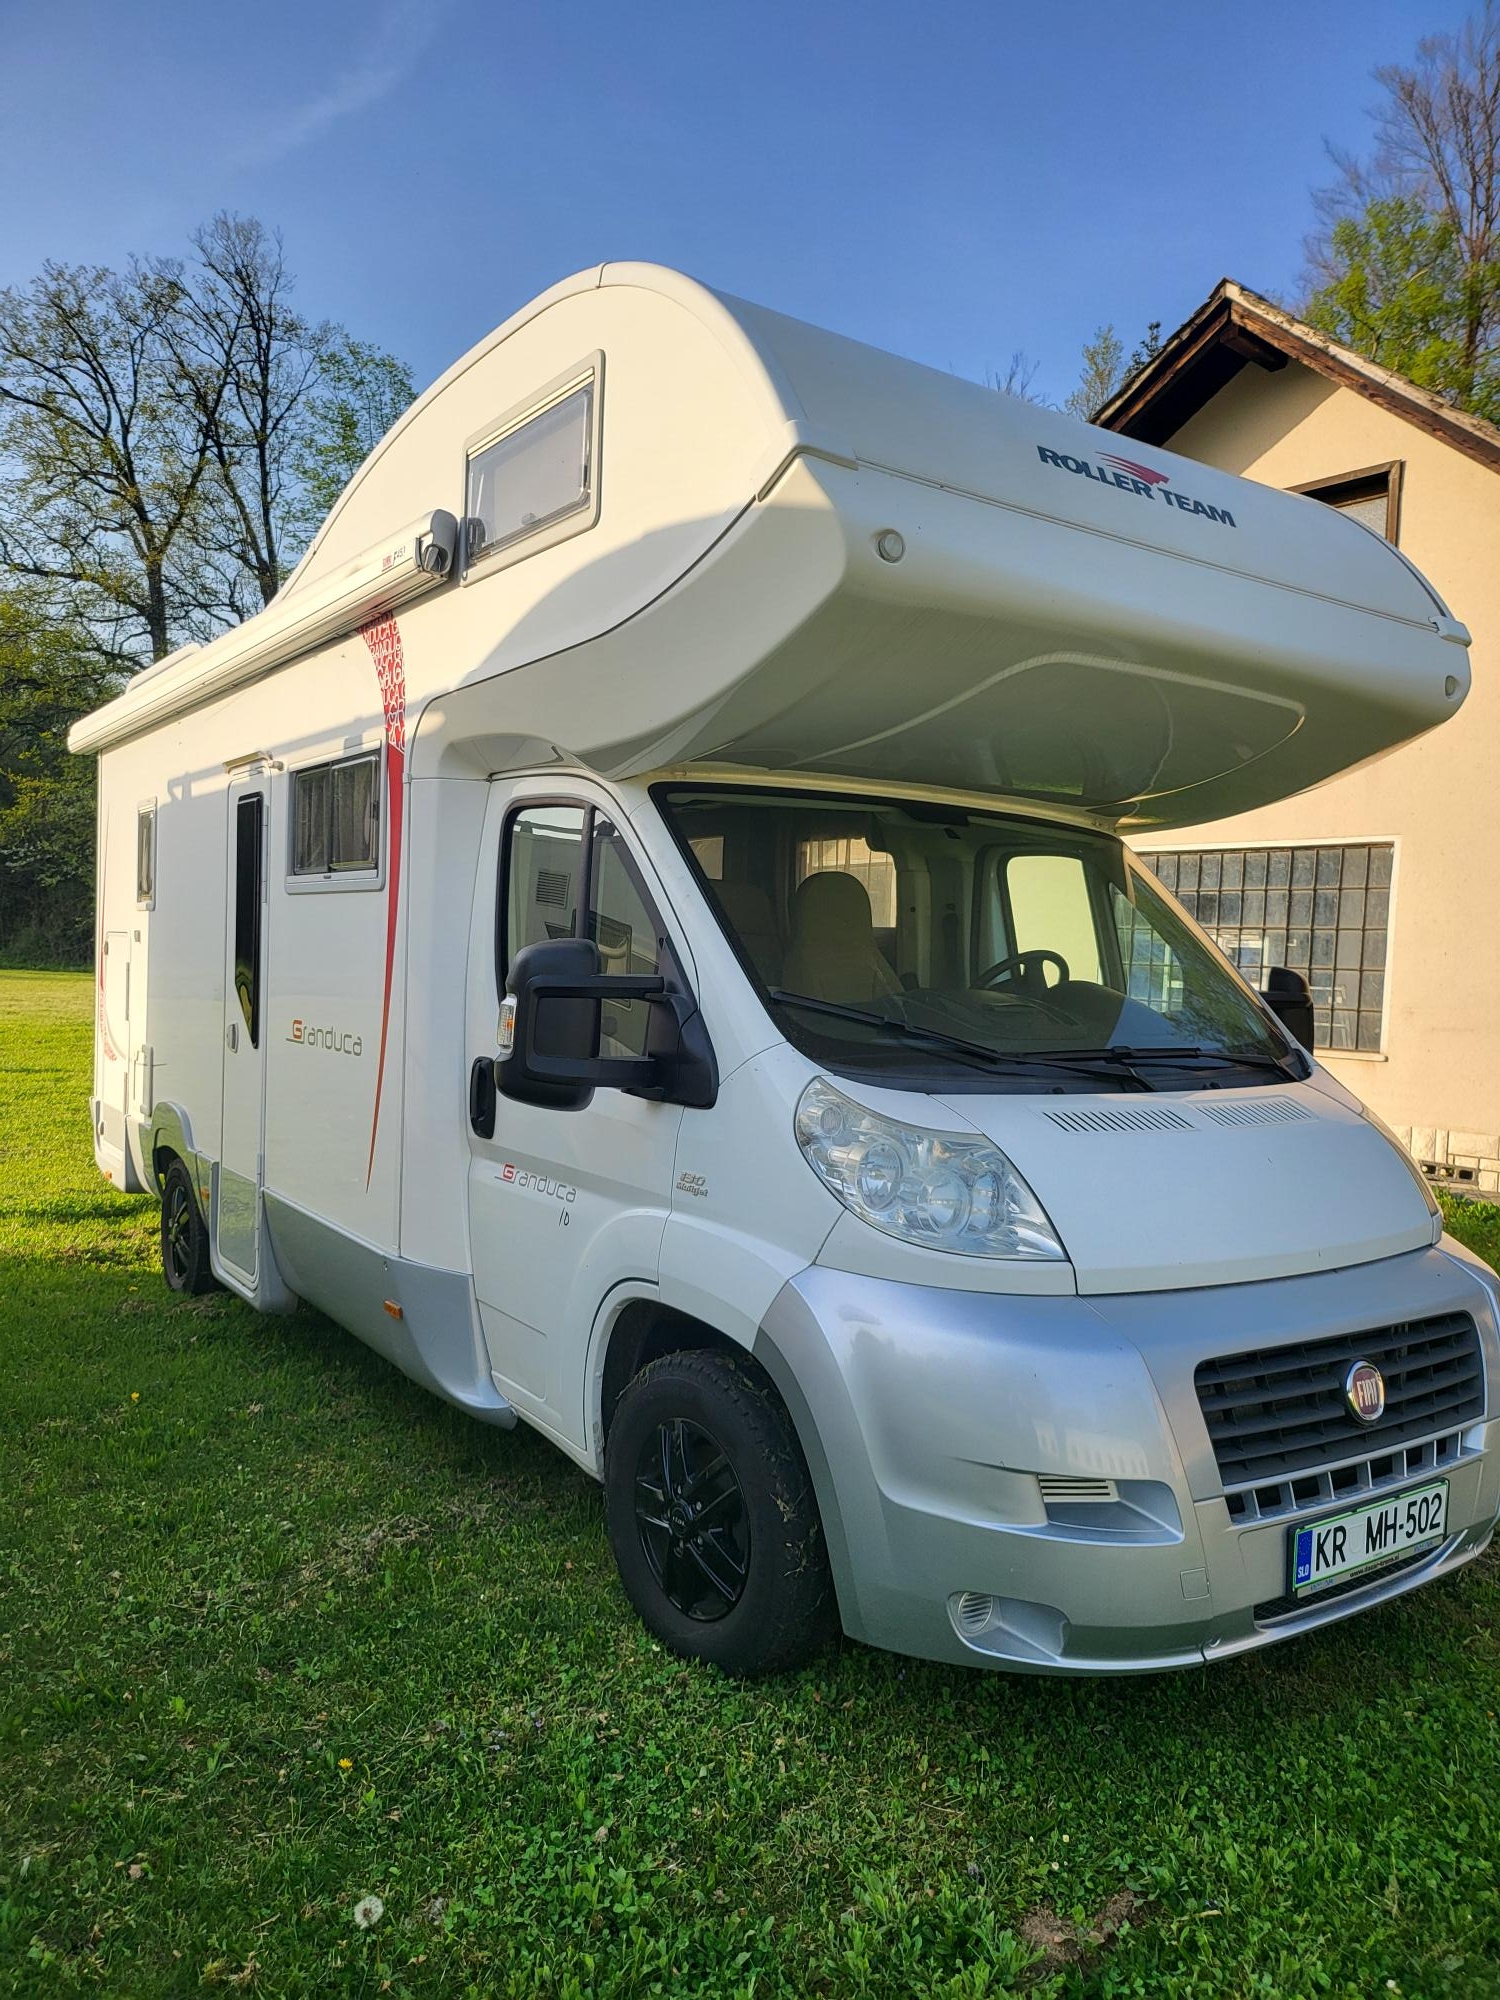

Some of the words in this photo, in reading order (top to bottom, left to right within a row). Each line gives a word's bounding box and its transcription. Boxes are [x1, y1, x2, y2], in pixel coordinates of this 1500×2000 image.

[1036, 445, 1156, 500] ROLLER
[1156, 486, 1237, 528] TEAM
[285, 1019, 363, 1057] Granduca
[494, 1163, 577, 1204] Granduca
[1297, 1563, 1310, 1579] SLO
[1315, 1525, 1347, 1572] KR
[1365, 1492, 1443, 1555] MH-502
